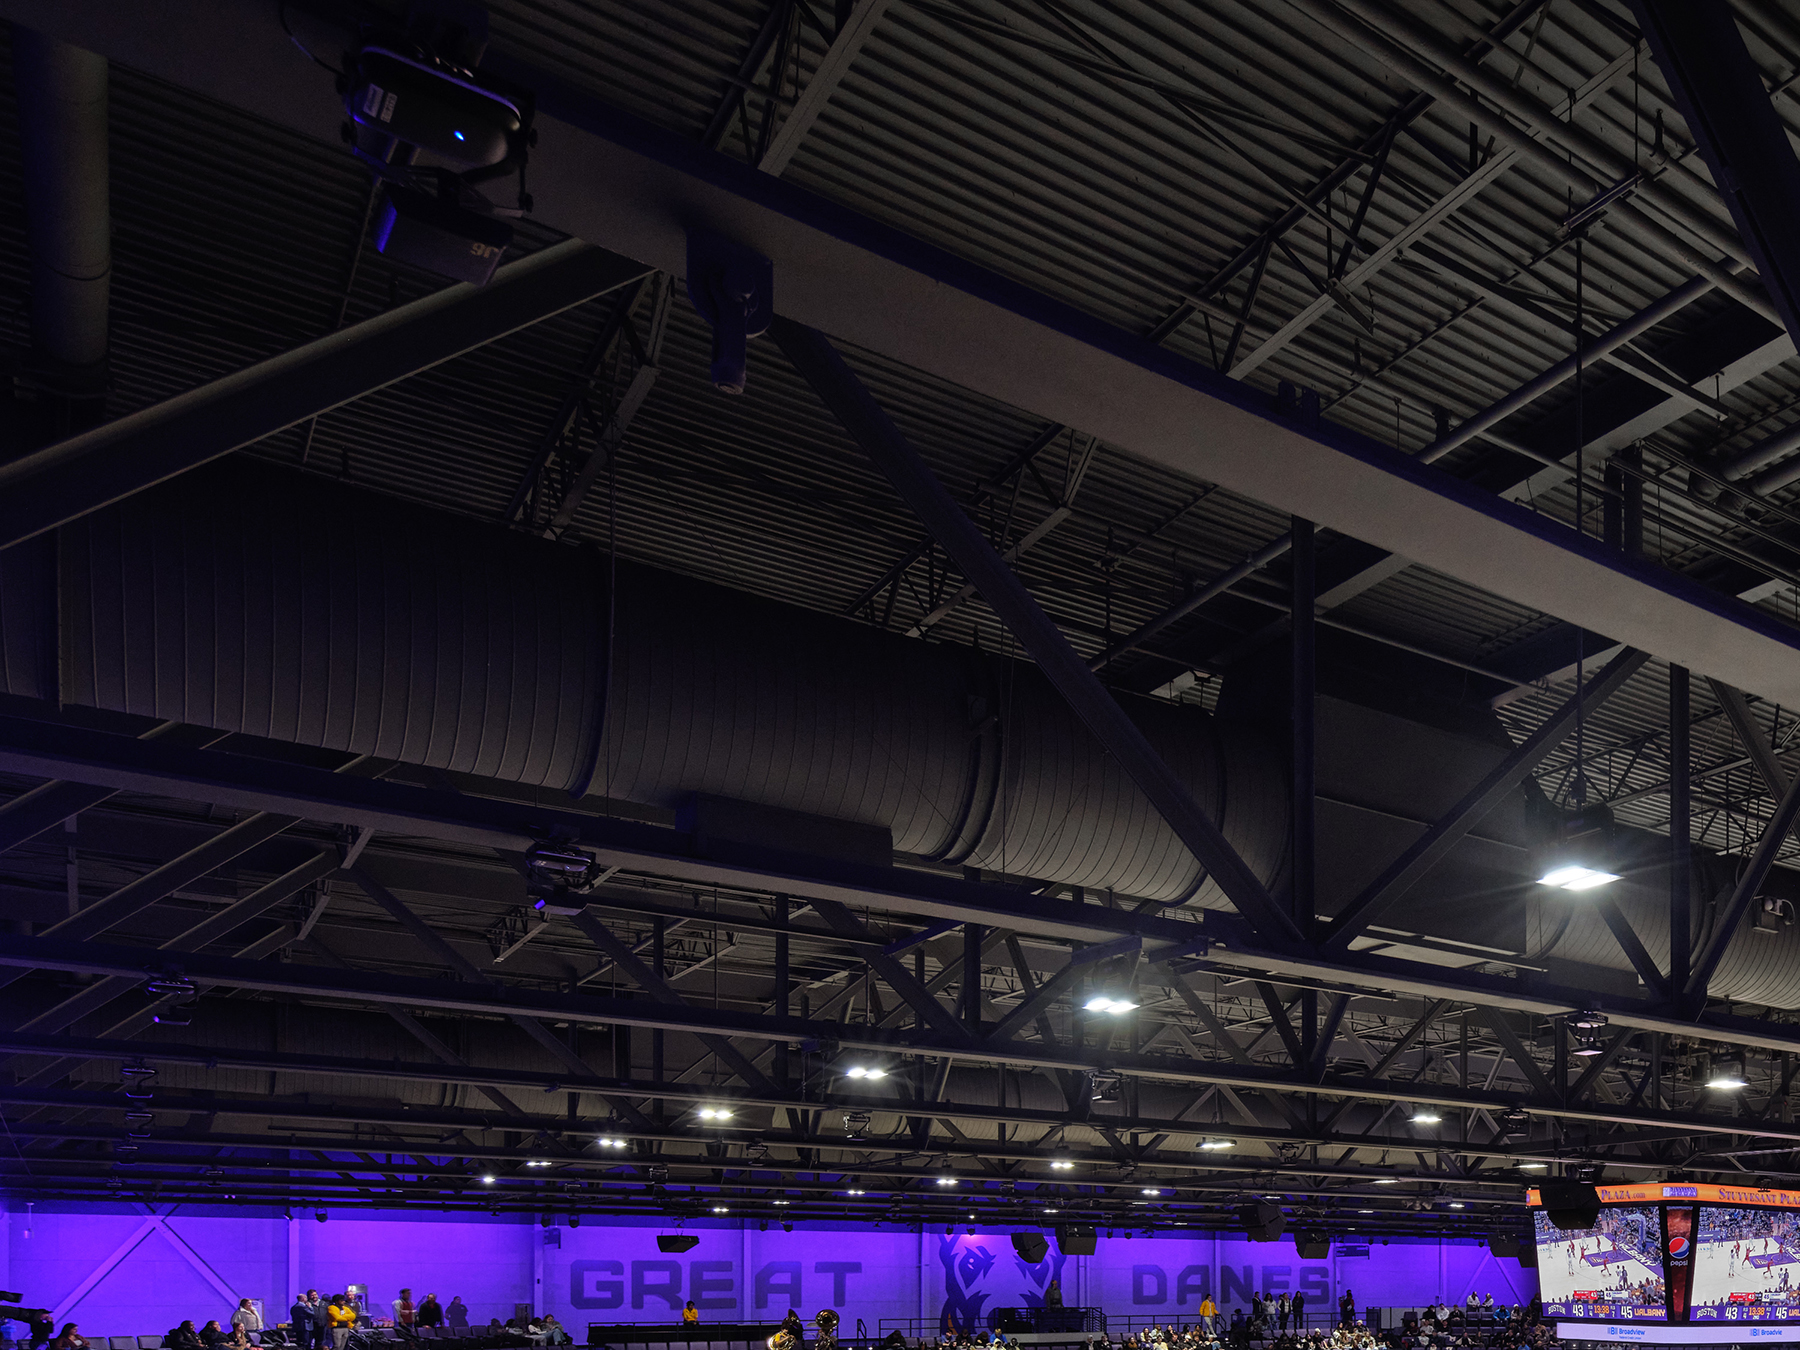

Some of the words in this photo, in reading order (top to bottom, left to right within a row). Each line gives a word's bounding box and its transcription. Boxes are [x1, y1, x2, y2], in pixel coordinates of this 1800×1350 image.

[1719, 1188, 1776, 1203] STUYVESANT
[570, 1260, 862, 1310] GREAT
[1132, 1265, 1329, 1305] DANES
[1572, 1304, 1584, 1317] 43
[1594, 1305, 1610, 1314] 13:38
[1621, 1306, 1633, 1319] 45
[1634, 1308, 1666, 1317] UALBANY
[1725, 1307, 1738, 1320] 43
[1748, 1307, 1765, 1316] 13:38
[1775, 1307, 1788, 1319] 45
[1619, 1328, 1646, 1336] Broadview
